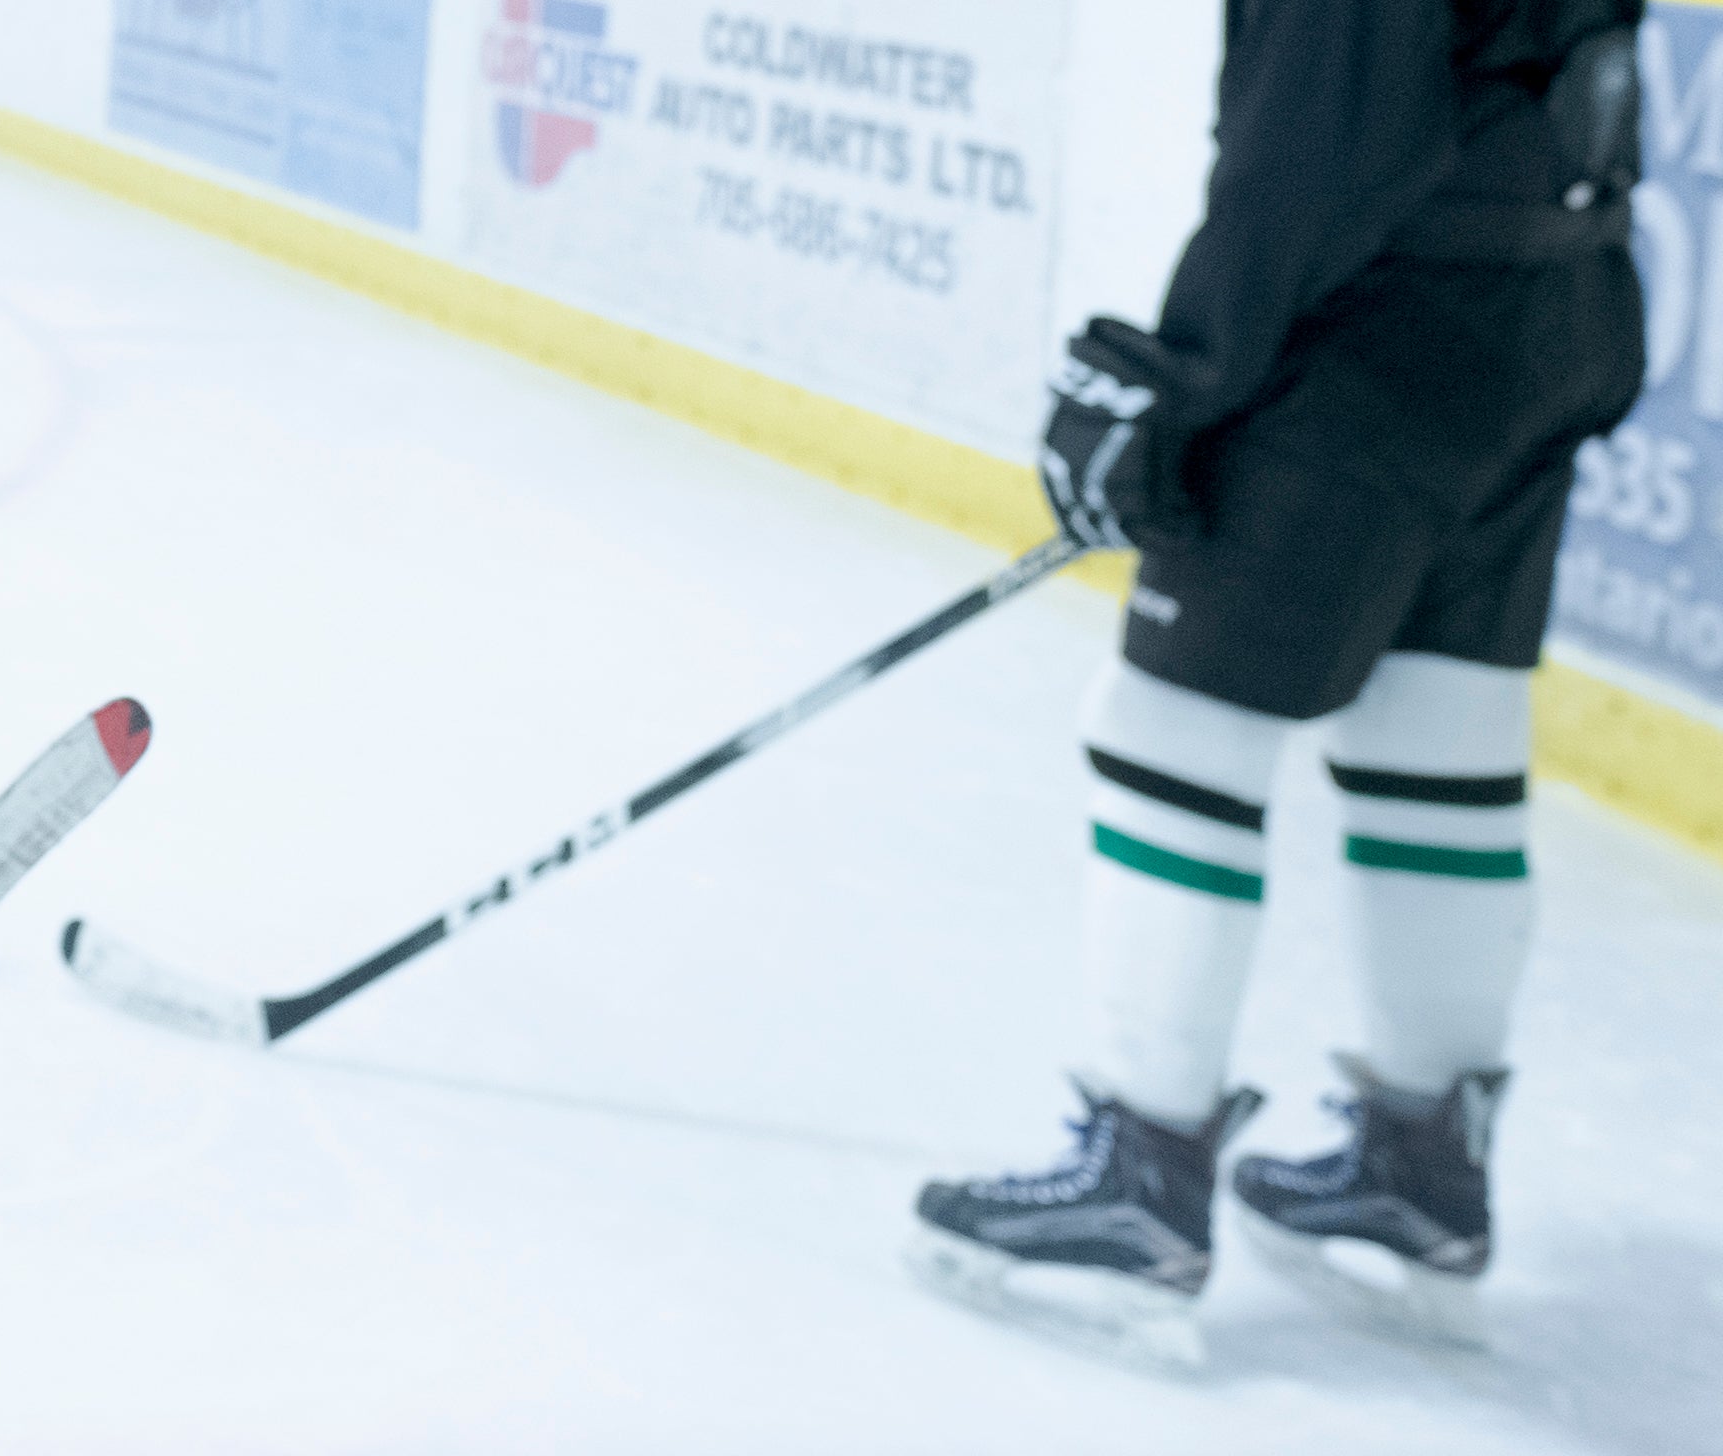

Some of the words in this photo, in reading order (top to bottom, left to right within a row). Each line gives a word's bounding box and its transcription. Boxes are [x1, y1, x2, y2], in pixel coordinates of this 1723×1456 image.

[705, 12, 976, 114] COLDWATER
[648, 74, 760, 148] AUTO
[767, 98, 914, 187] PARTS
